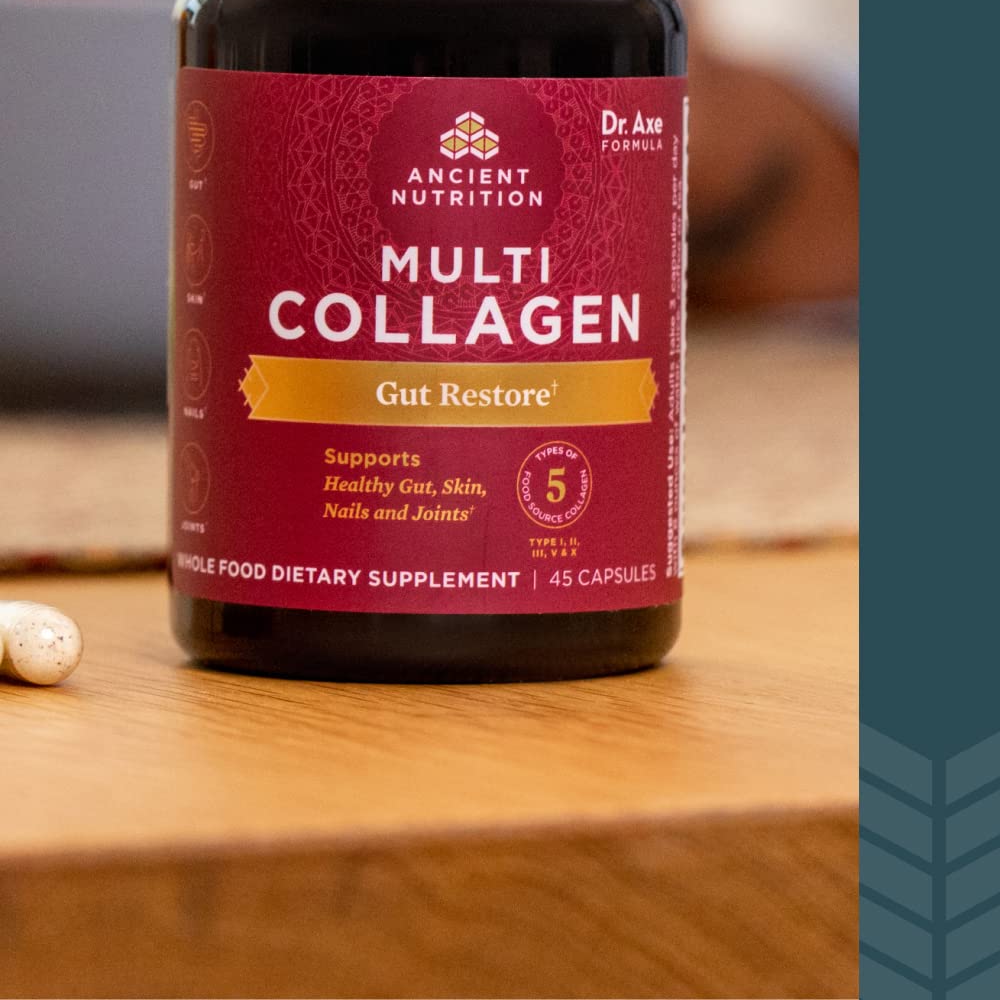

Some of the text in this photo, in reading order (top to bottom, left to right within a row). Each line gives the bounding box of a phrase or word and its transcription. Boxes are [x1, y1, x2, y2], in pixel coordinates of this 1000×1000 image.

[601, 110, 663, 135] Dr. Axe
[602, 139, 663, 152] FORMULA
[408, 168, 530, 184] ANCIENT
[392, 190, 543, 207] NUTRITION
[381, 246, 550, 283] MULTI
[269, 290, 640, 345] COLLAGEN
[376, 381, 432, 406] Gut
[324, 447, 421, 469] Supports
[535, 446, 578, 462] TYPES OF
[323, 475, 487, 498] Healthy Gut, Skin,
[546, 466, 566, 503] 5
[521, 469, 589, 524] FOOD SOURCE COLLAGEN
[322, 502, 370, 520] Nails
[373, 503, 408, 521] and
[529, 537, 557, 547] TYPE
[551, 548, 558, 557] V
[570, 548, 577, 557] X
[176, 551, 657, 589] WHOLE FOOD DIETARY SUPPLEMENT 45 CAPSULES
